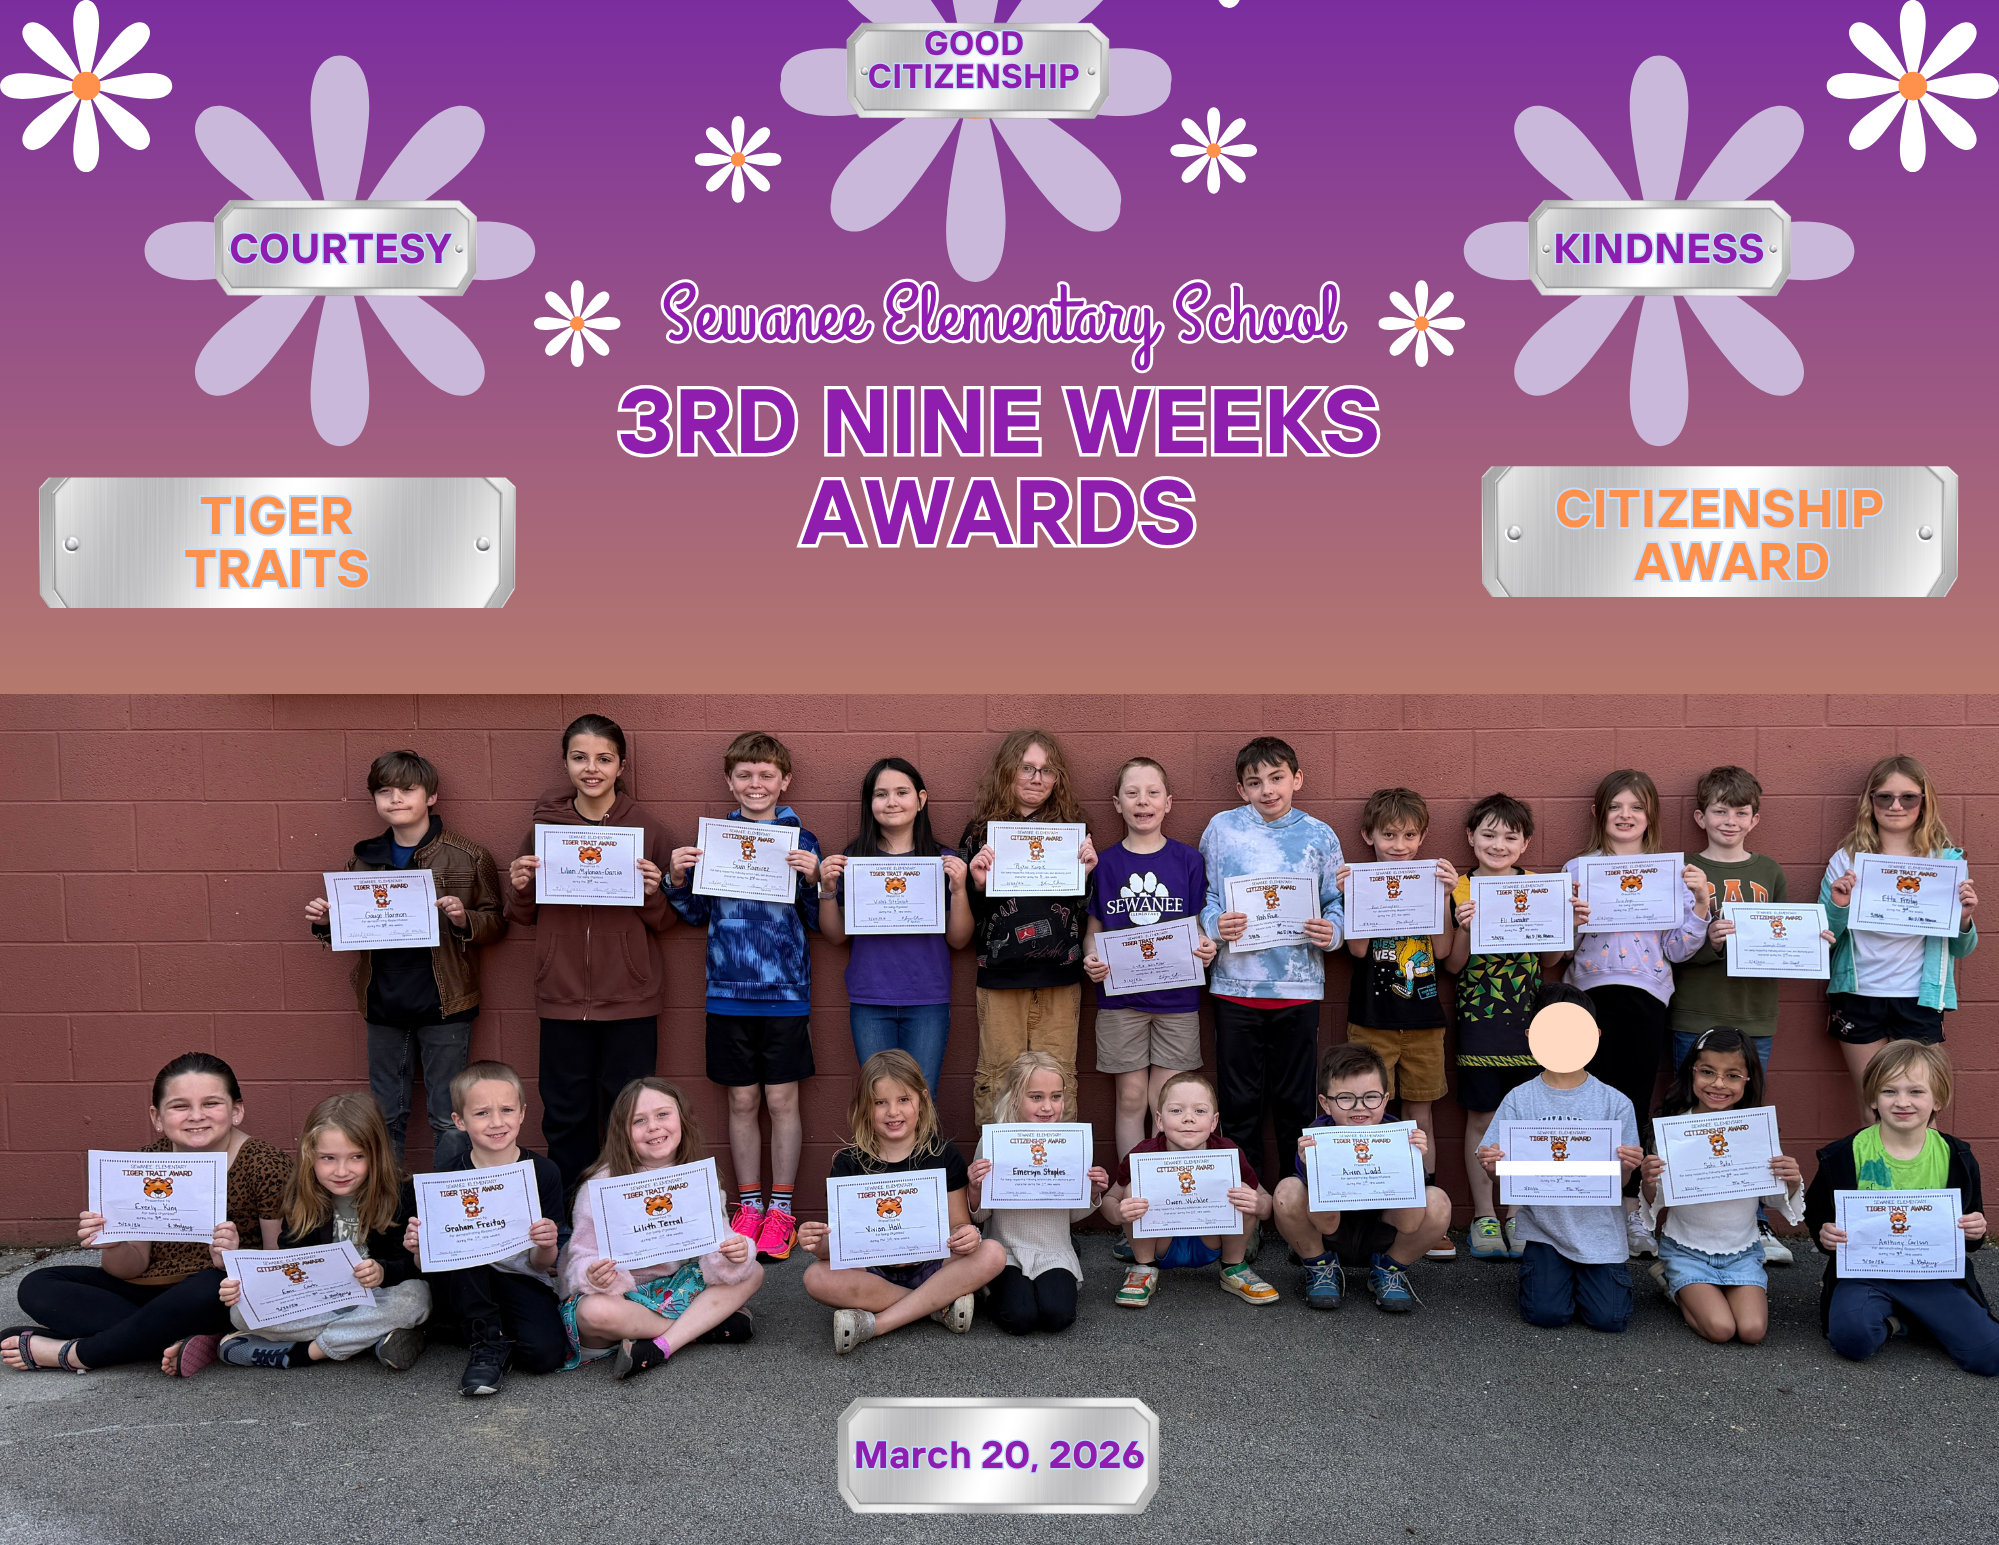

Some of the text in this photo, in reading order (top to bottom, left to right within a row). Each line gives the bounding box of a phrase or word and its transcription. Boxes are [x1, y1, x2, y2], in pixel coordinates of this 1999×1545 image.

[722, 833, 756, 841] CITIZENSHIP
[1246, 885, 1279, 893] CITIZENSHIP
[1107, 897, 1183, 915] SEWANEE
[1373, 950, 1397, 961] VES
[1684, 1127, 1726, 1137] CITIZENSHIP
[459, 1187, 479, 1196] TRAIT
[482, 1184, 504, 1193] AWARD
[623, 1182, 689, 1200] TIGER TRAIT AWARD
[445, 1222, 474, 1233] Graham
[476, 1219, 506, 1228] Freitag
[633, 1217, 683, 1233] Lilith Terral
[256, 1258, 325, 1273] CITIZENSHIP AWARD
